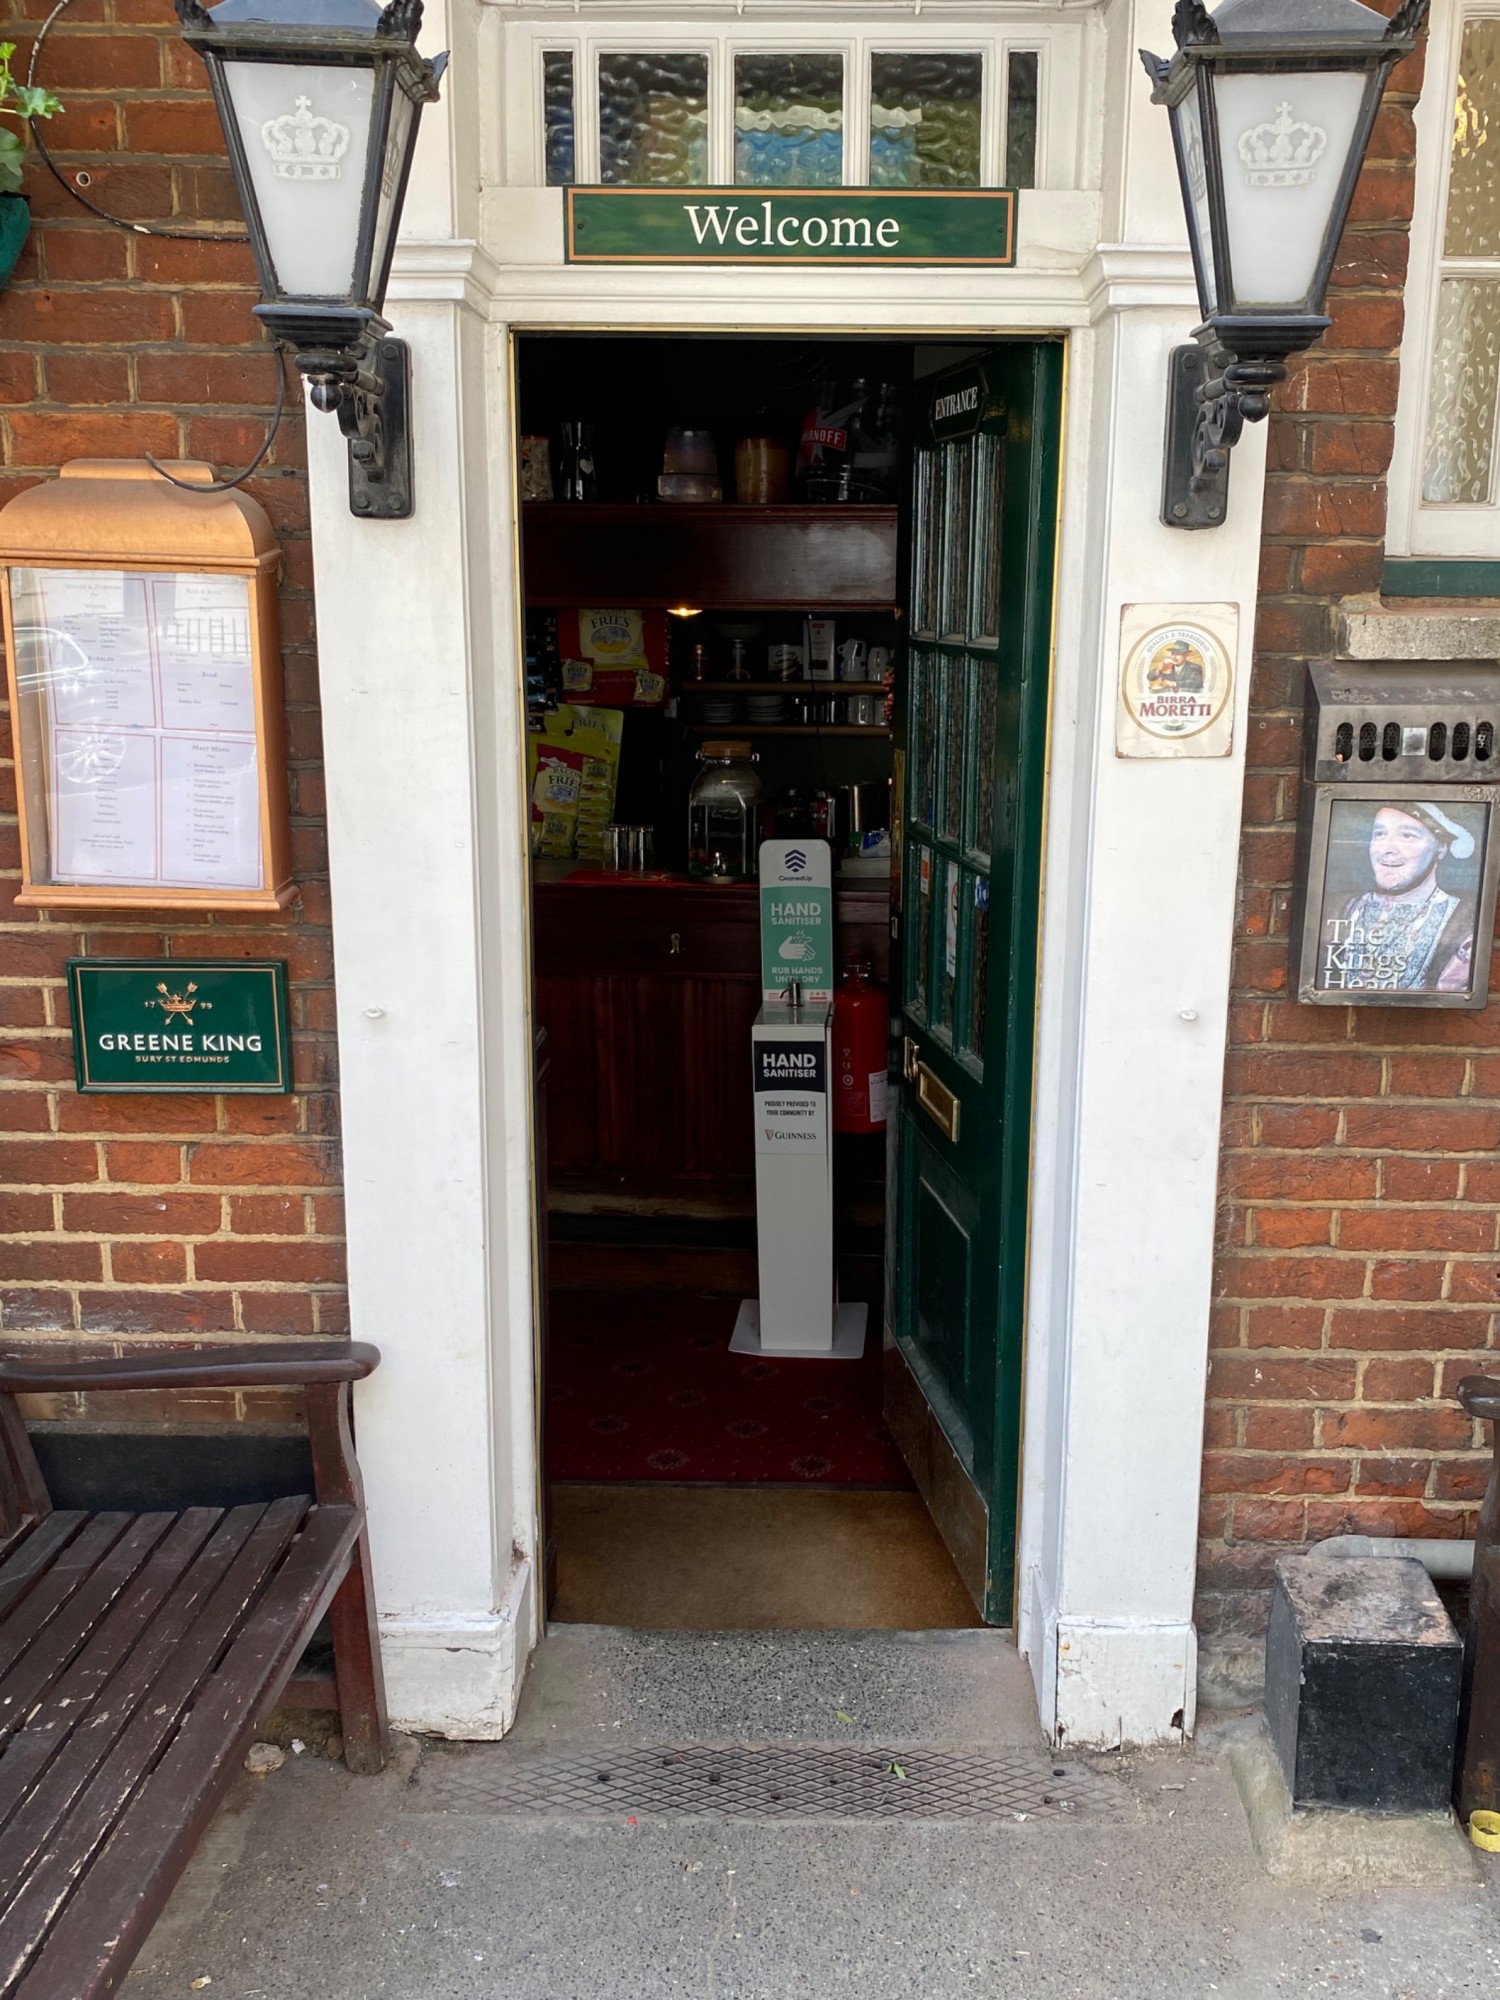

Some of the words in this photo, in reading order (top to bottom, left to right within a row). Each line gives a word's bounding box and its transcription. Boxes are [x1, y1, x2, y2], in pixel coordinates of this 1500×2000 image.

[684, 201, 900, 247] Welcome
[935, 386, 978, 420] ENTRANCE
[591, 616, 631, 629] FRIES
[1140, 702, 1212, 717] MORETTI
[771, 902, 822, 916] HAND
[771, 917, 822, 925] SANITISER
[1327, 919, 1384, 946] The
[1324, 945, 1407, 979] Kings
[144, 1001, 156, 1009] 17
[99, 1034, 193, 1052] GREENE
[202, 1034, 262, 1052] KING
[135, 1055, 163, 1063] BURY
[179, 1056, 230, 1064] EDMUNDS
[763, 1053, 816, 1068] HAND
[763, 1069, 816, 1078] SANITISER
[774, 1131, 817, 1140] GUINNESS
